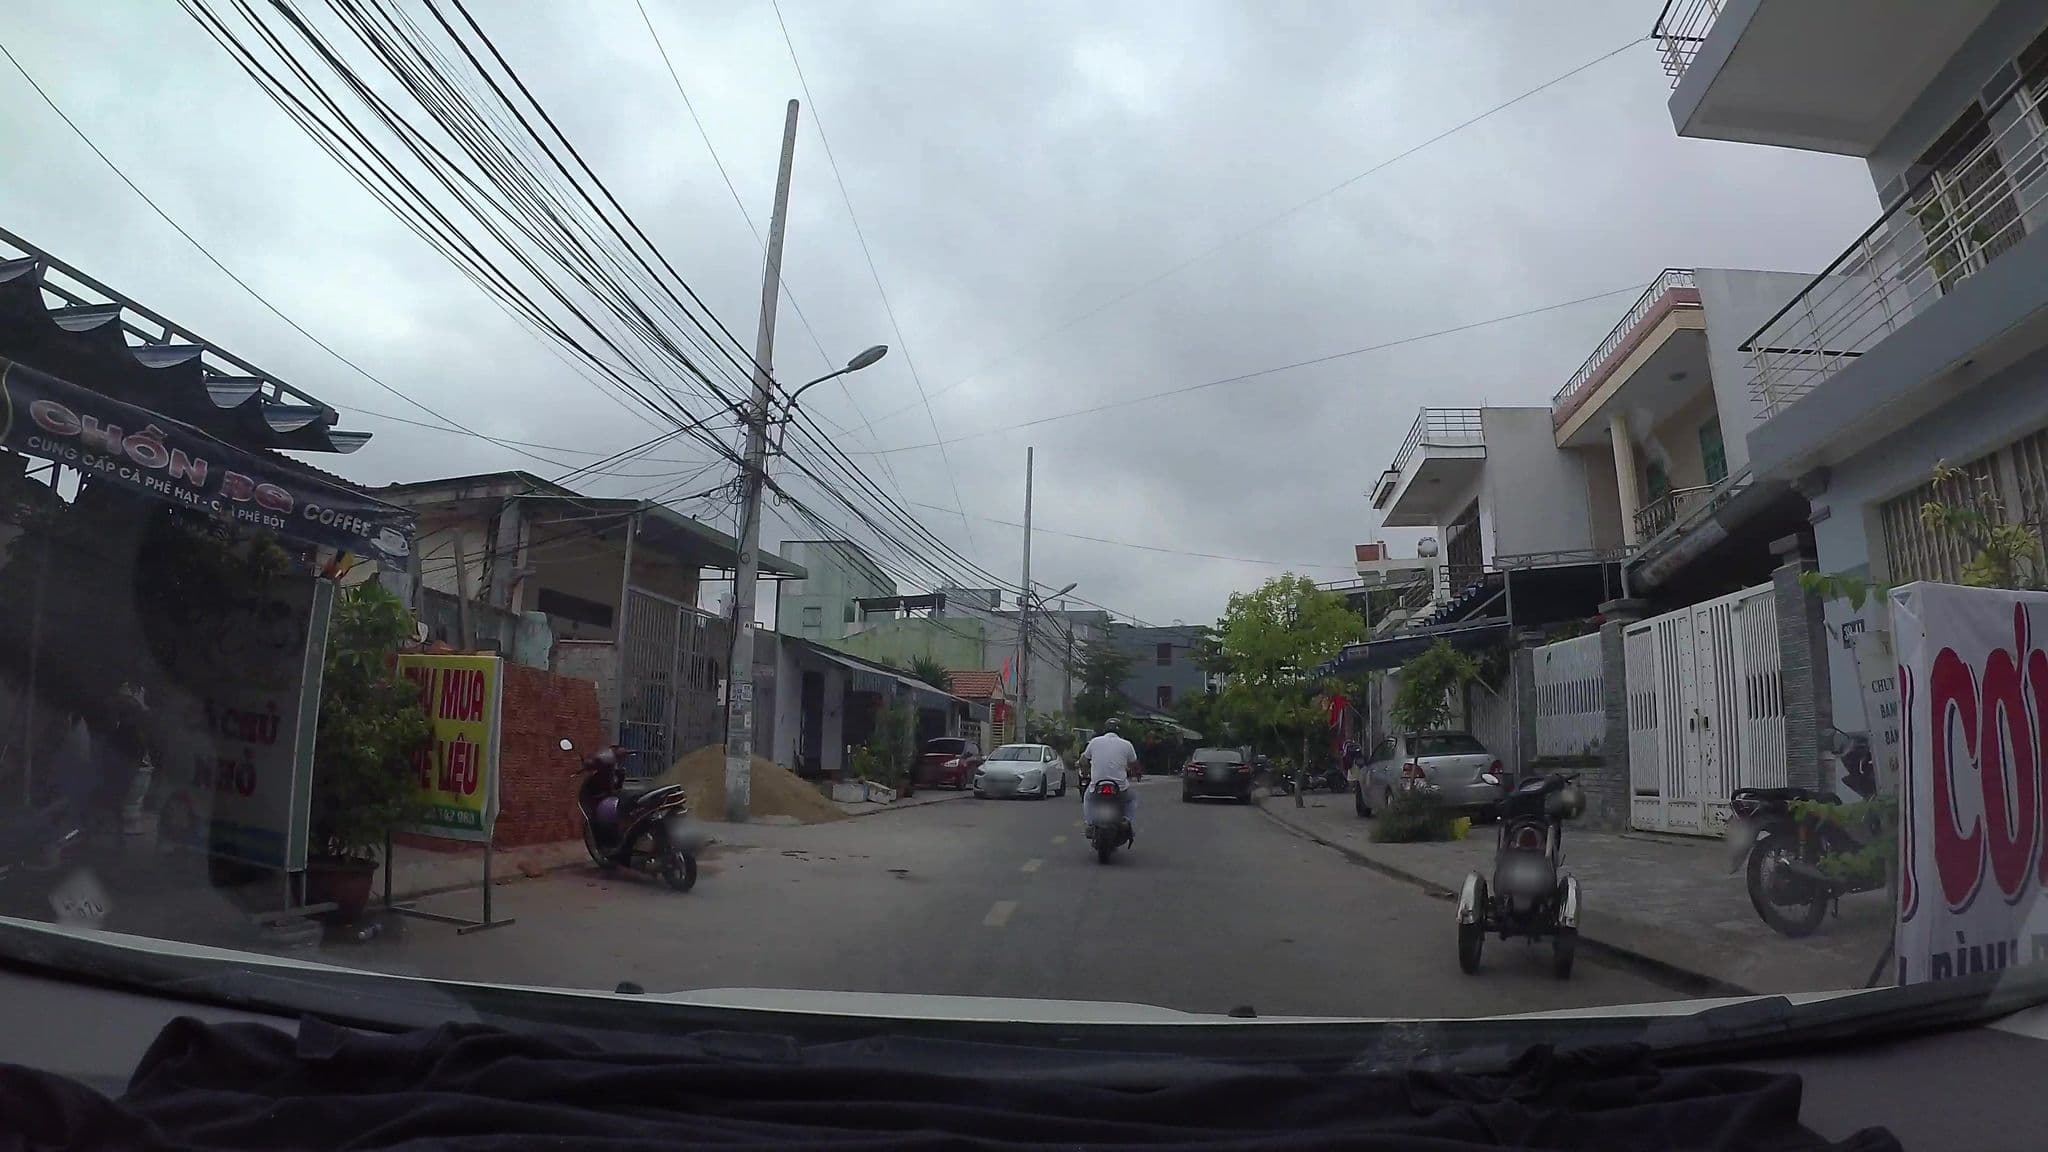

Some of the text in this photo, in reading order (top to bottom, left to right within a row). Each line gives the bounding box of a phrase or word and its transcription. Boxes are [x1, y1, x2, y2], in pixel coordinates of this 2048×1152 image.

[27, 436, 77, 460] CUNG
[82, 455, 116, 473] CẤP
[145, 476, 171, 494] PHÊ
[238, 508, 260, 524] PHÊ
[303, 503, 373, 538] COFFEE
[438, 668, 486, 722] MUA
[438, 732, 481, 803] LIỆU
